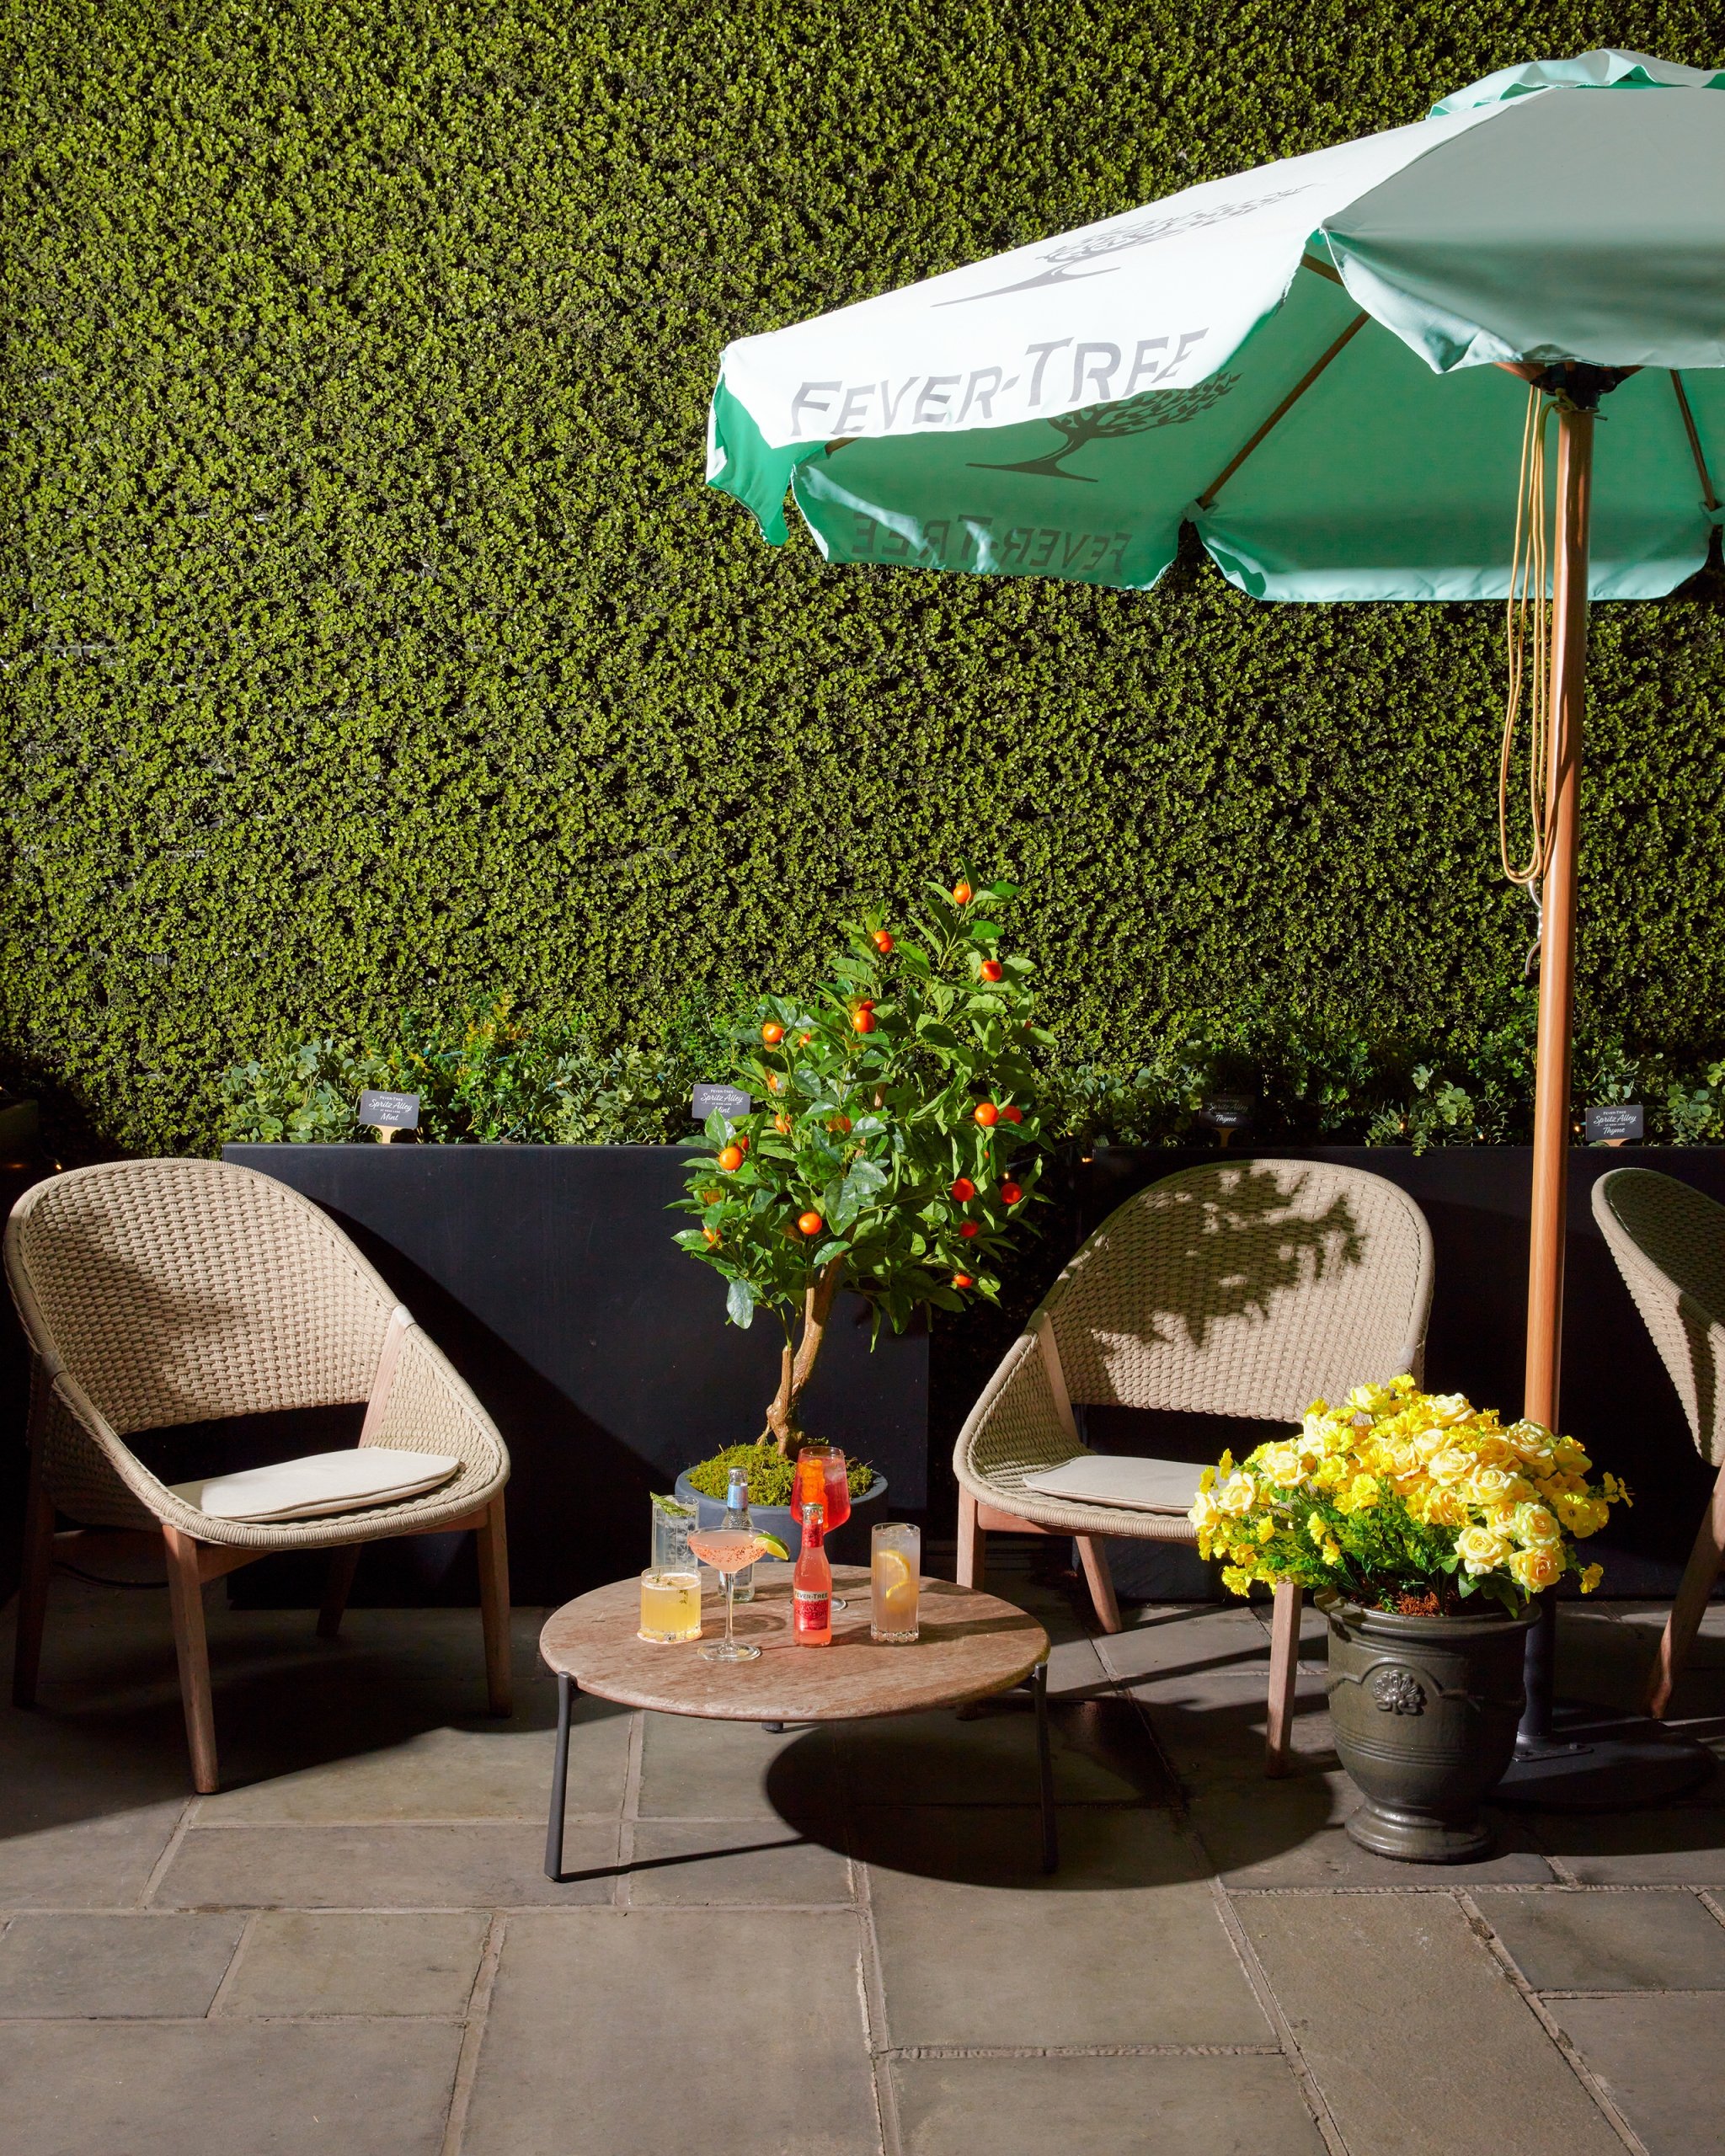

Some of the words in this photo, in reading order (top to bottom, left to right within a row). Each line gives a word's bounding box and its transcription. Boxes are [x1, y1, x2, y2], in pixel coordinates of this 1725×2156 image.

[790, 327, 1210, 436] FEVER-TREE
[701, 1092, 724, 1103] Spritz
[724, 1094, 744, 1104] Alley
[369, 1098, 393, 1109] Spritz
[393, 1102, 413, 1113] Alley
[380, 1113, 399, 1121] Mint
[1215, 1114, 1237, 1123] Thyme
[1594, 1115, 1616, 1126] Spritz
[1616, 1114, 1637, 1123] Alley
[1603, 1127, 1626, 1135] Thyme
[794, 1591, 828, 1599] FEVER-TREE
